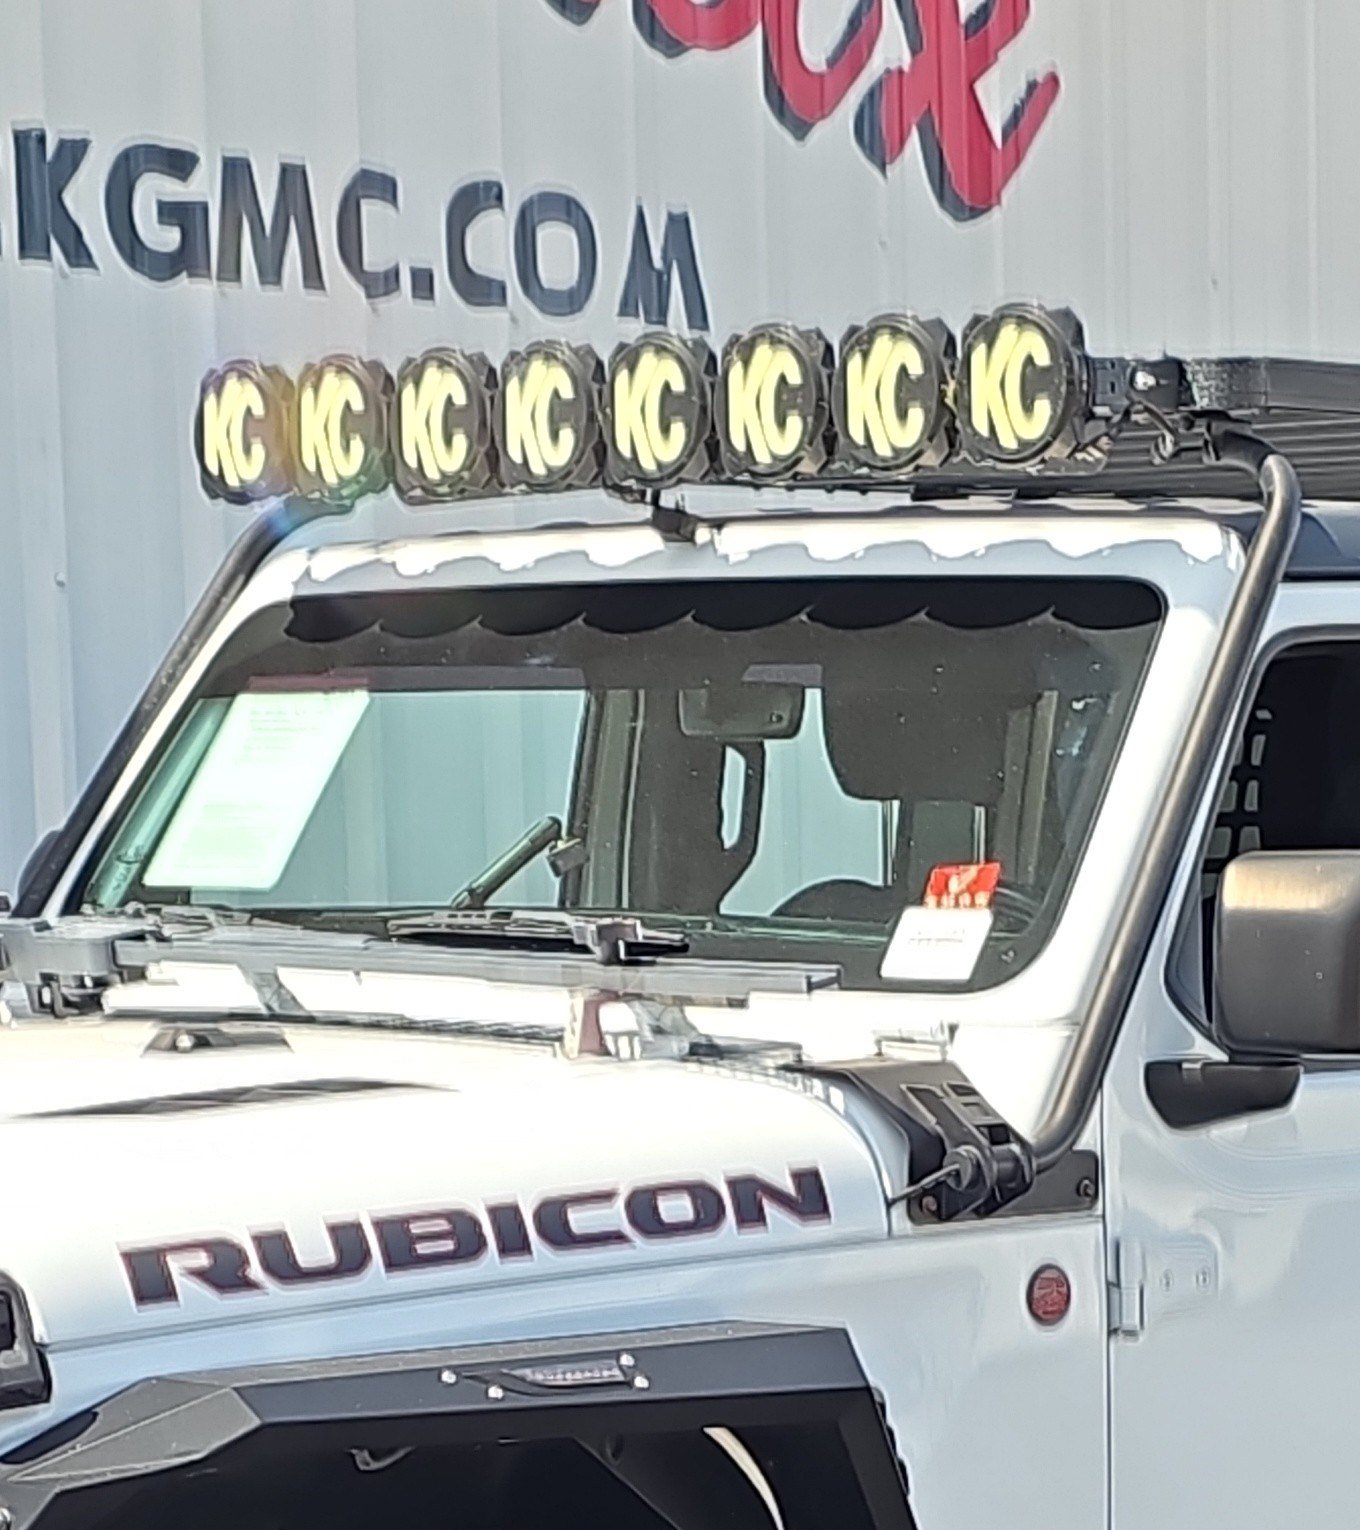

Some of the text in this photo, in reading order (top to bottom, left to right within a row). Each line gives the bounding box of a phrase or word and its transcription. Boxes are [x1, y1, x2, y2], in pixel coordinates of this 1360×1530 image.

[203, 372, 267, 488] KC
[301, 366, 365, 487] KC
[401, 362, 469, 482] KC
[504, 357, 576, 477] KC
[614, 346, 686, 471] KC
[728, 341, 802, 464] KC
[846, 331, 924, 458] KC
[970, 320, 1051, 450] KC
[120, 1165, 832, 1307] RUBICON
